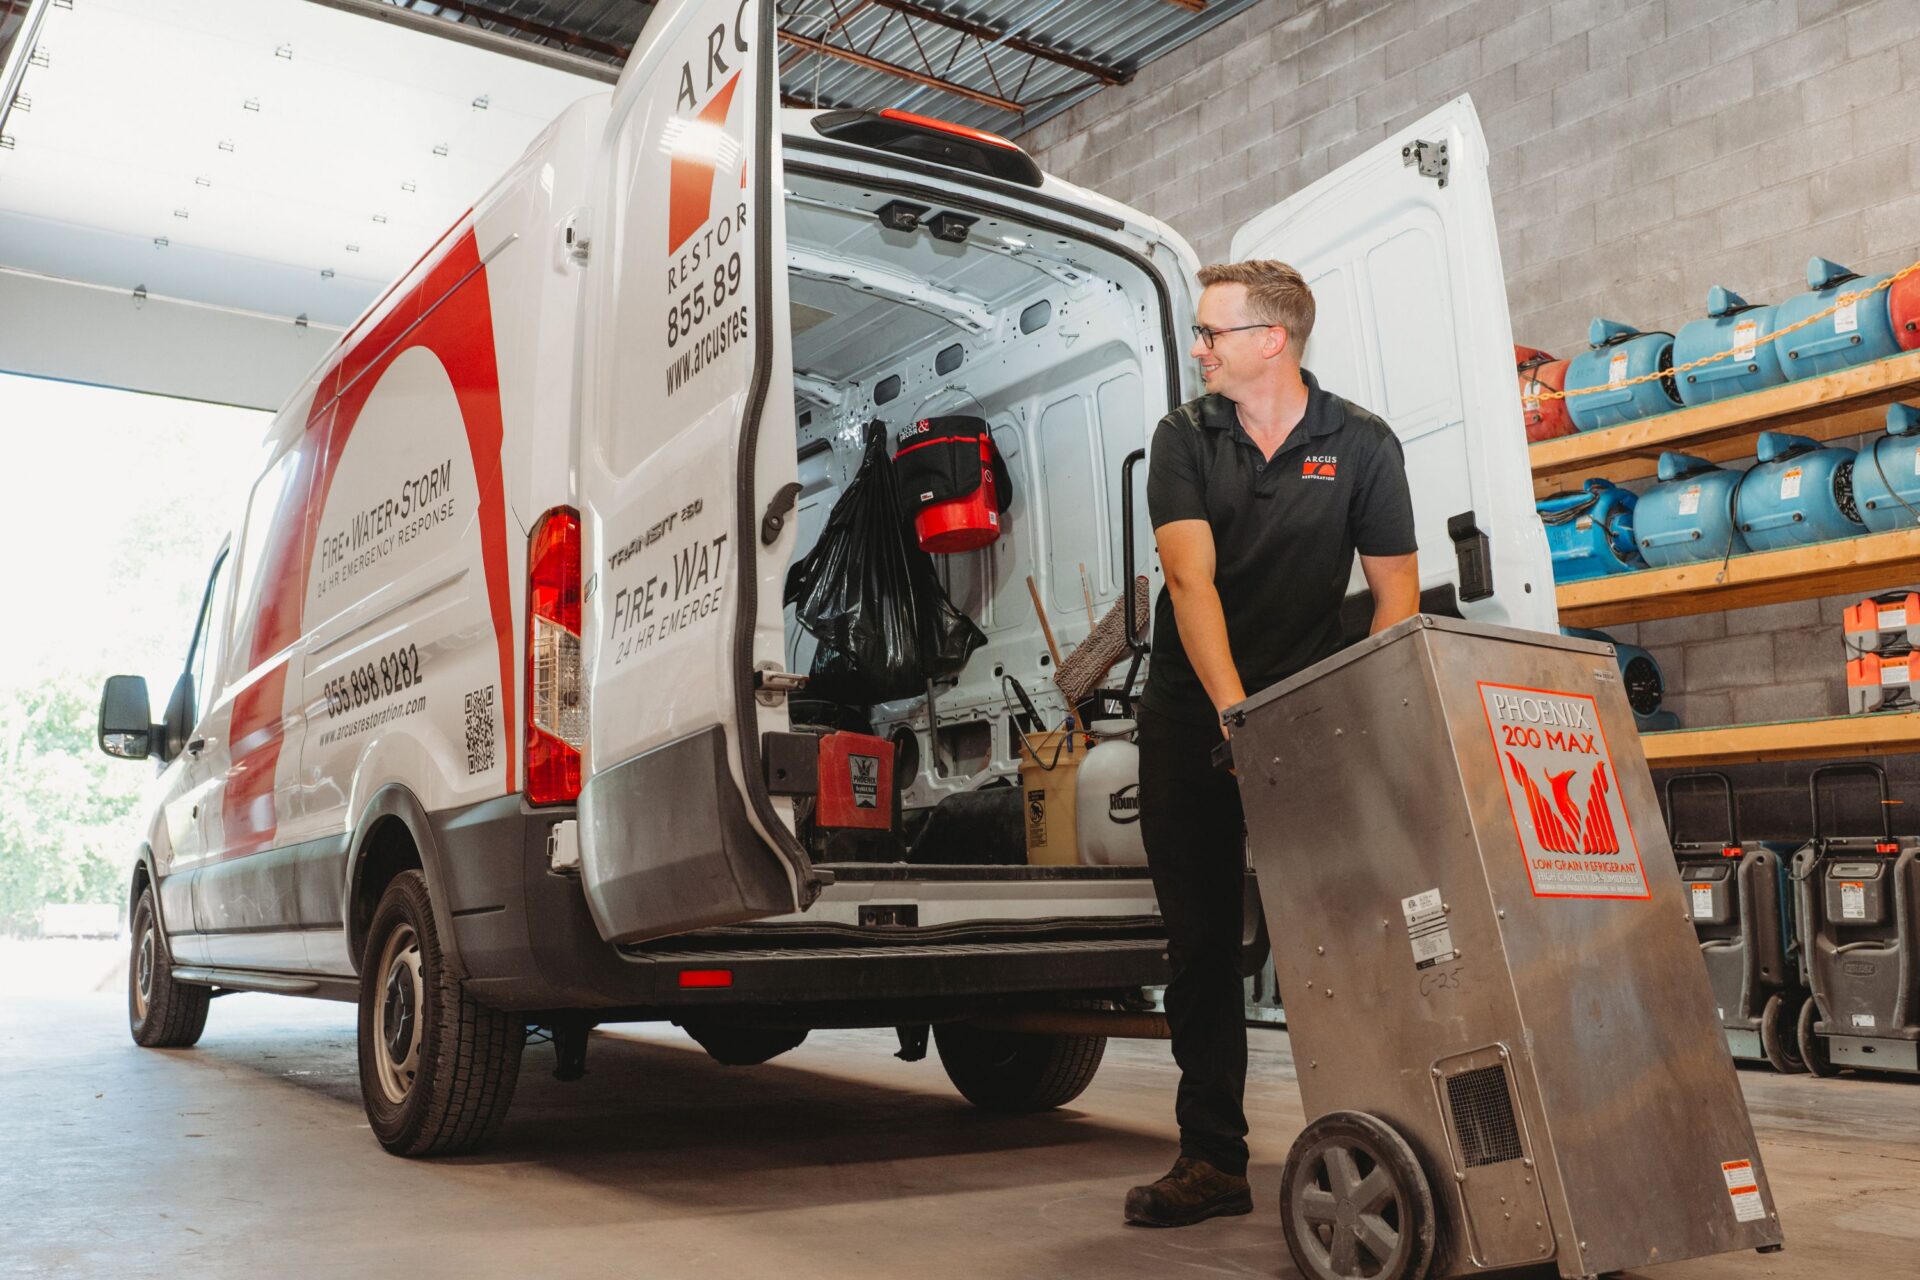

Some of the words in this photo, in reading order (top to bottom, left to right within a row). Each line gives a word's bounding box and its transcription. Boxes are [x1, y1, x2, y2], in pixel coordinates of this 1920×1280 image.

[668, 251, 741, 348] 855.89
[666, 306, 747, 397] www.arcusres
[1304, 455, 1337, 463] ARCUS
[318, 581, 327, 598] 24
[329, 574, 340, 592] HR
[342, 541, 396, 582] EMERGENCY
[398, 499, 454, 548] RESPONSE
[322, 531, 345, 573] FIRE
[352, 498, 393, 552] WATER
[401, 459, 451, 519] STORM
[608, 512, 678, 570] TRANSIT
[611, 574, 657, 640] FIRE
[673, 532, 727, 601] WAT
[615, 636, 631, 665] 24
[635, 624, 654, 654] HR
[658, 587, 722, 641] EMERGE
[324, 643, 422, 719] 855.898.8282
[1493, 694, 1592, 729] PHOENIX
[319, 695, 426, 747] www.arcusrestoration.com
[1502, 724, 1541, 748] 200
[1544, 729, 1600, 755] MAX
[1532, 859, 1552, 870] LOW
[1555, 860, 1582, 871] GRAIN
[1583, 861, 1637, 873] REFRIGERANT
[1419, 967, 1464, 997] C-25
